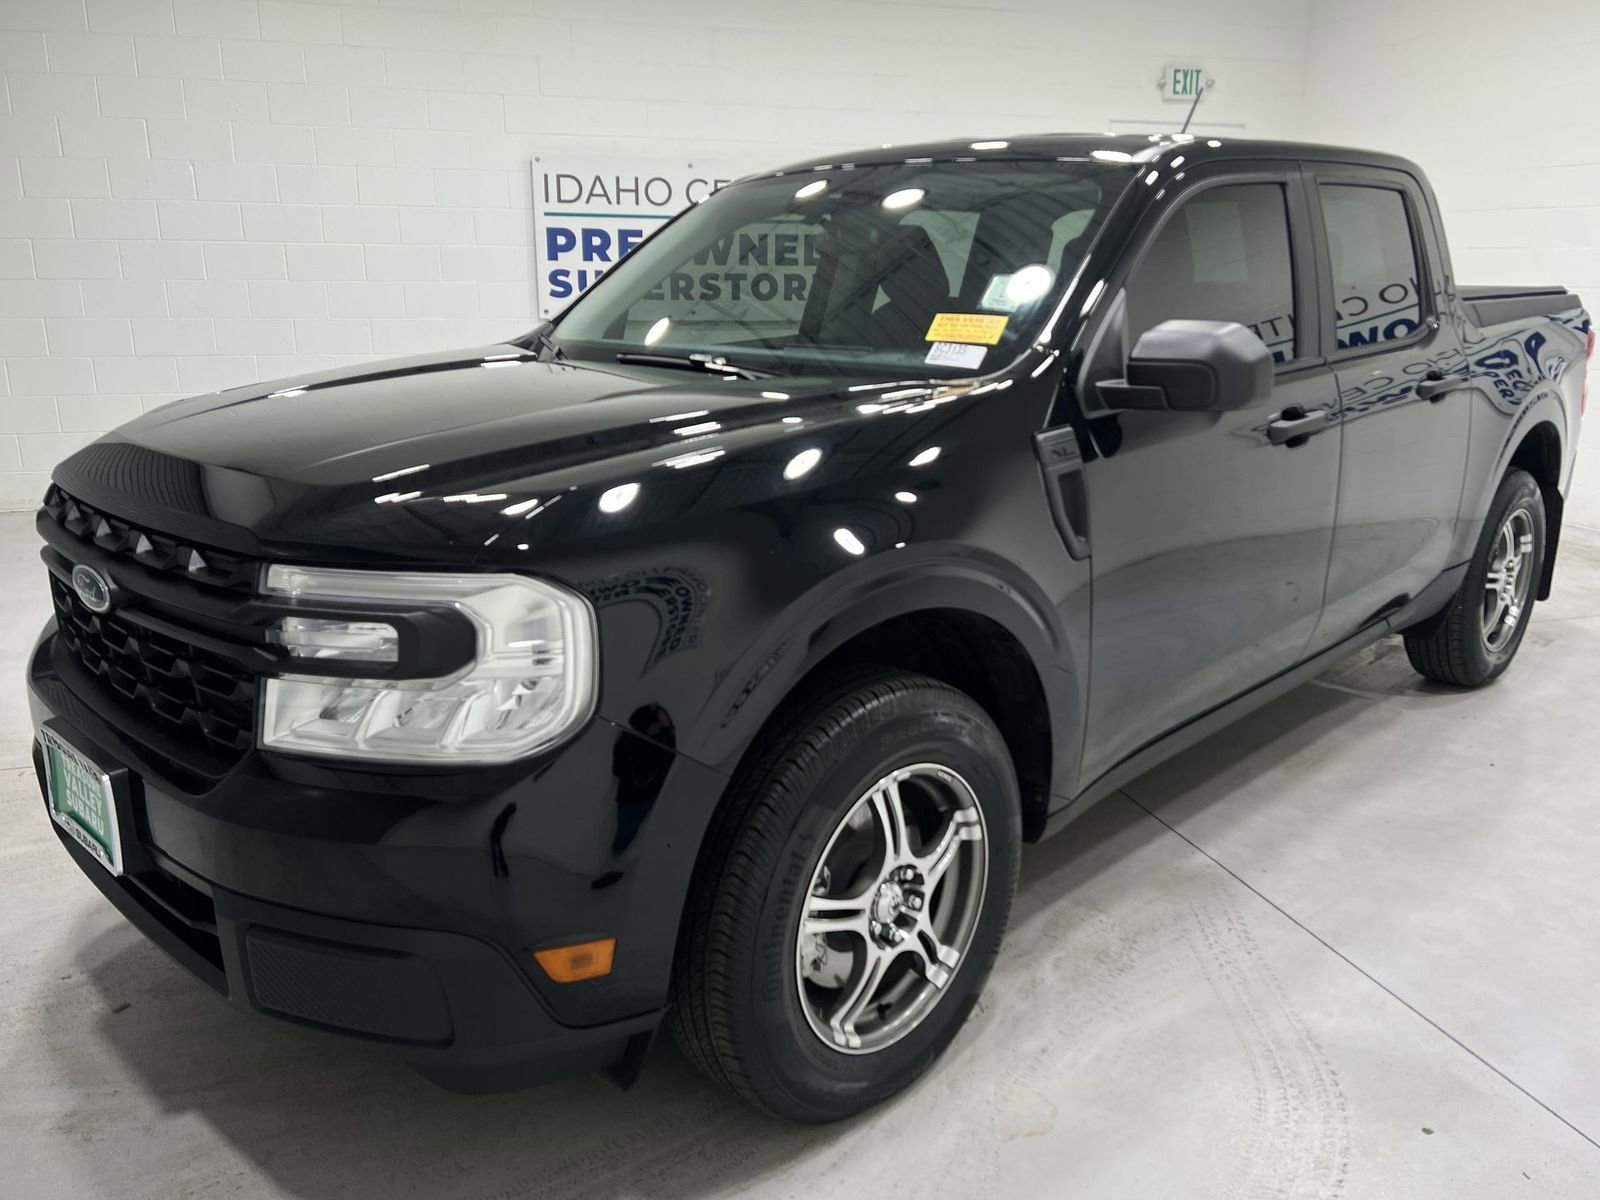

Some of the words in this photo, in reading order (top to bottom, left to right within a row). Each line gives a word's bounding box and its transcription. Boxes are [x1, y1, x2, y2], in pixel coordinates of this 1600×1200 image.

[1172, 68, 1202, 95] EXIT
[543, 172, 673, 207] IDAHO
[63, 769, 102, 808] VALLEY
[66, 791, 104, 836] SUBARU
[761, 850, 805, 1003] Continental
